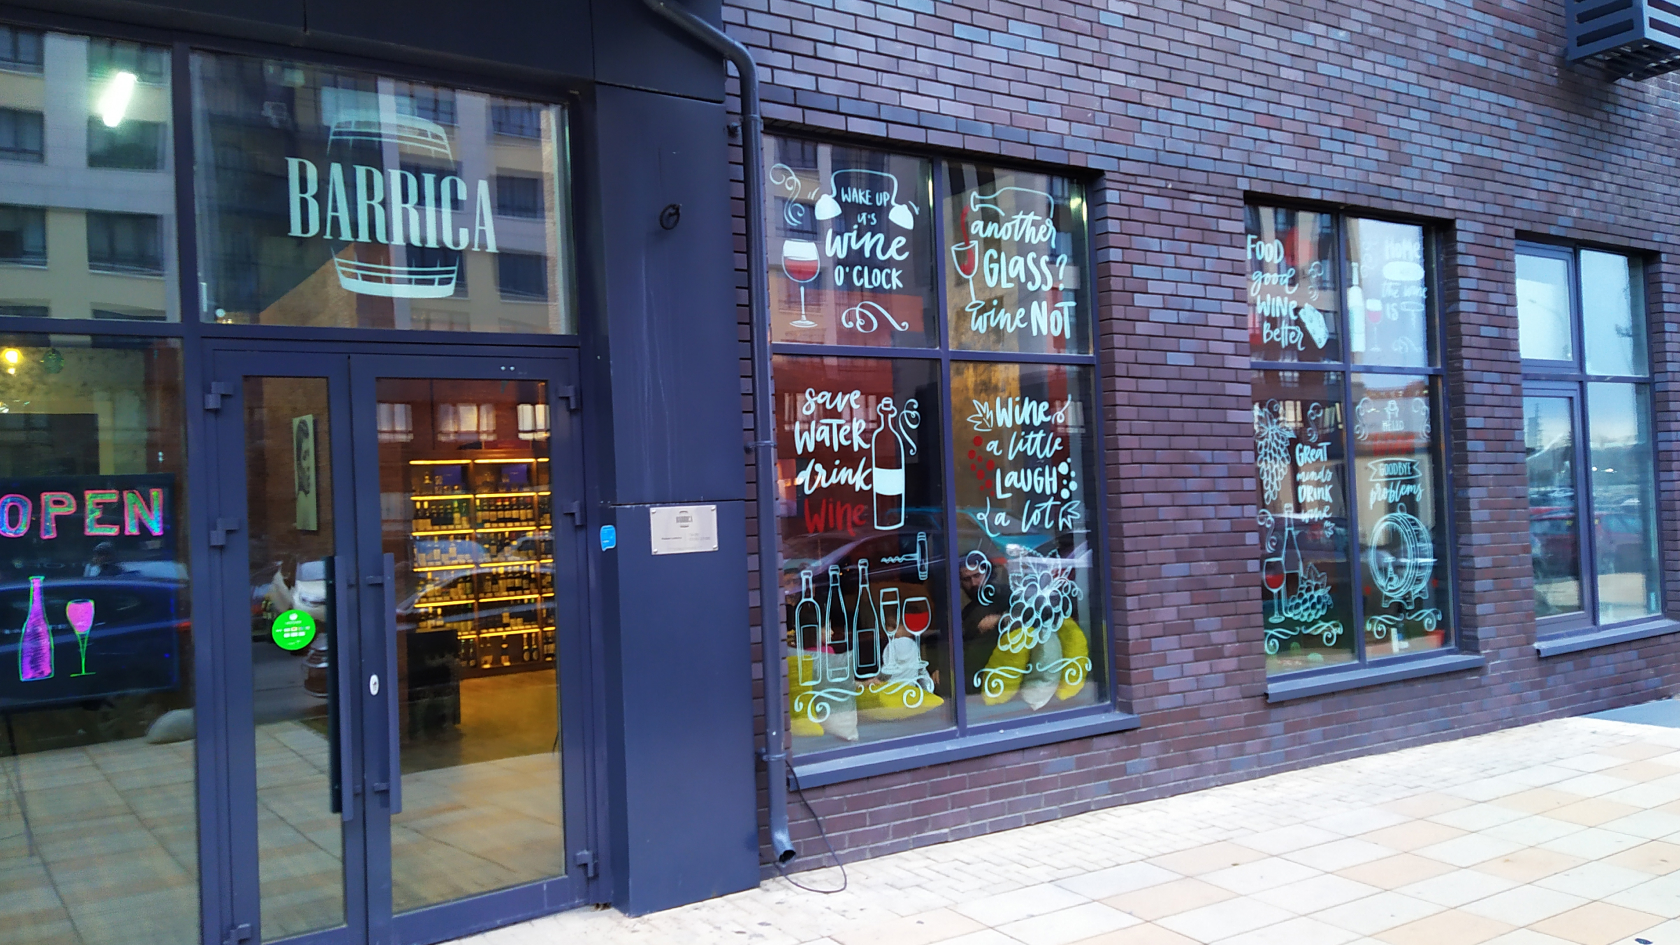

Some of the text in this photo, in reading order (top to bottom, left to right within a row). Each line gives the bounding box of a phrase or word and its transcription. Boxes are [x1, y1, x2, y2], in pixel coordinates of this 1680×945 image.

[285, 156, 499, 254] BARRICA
[841, 186, 891, 207] WAKE UP
[825, 224, 909, 261] wine
[970, 210, 1056, 249] another
[1246, 233, 1285, 264] FOOD
[834, 264, 904, 290] O'CLOCK
[1250, 267, 1299, 297] good
[968, 299, 1028, 334] wine
[802, 388, 861, 415] save
[986, 429, 1064, 461] a little
[796, 456, 872, 495] drink
[1296, 465, 1333, 483] minds
[1379, 462, 1412, 477] GOODBYE
[1369, 481, 1424, 511] problems
[0, 488, 164, 540] OPEN
[994, 496, 1061, 533] a lot
